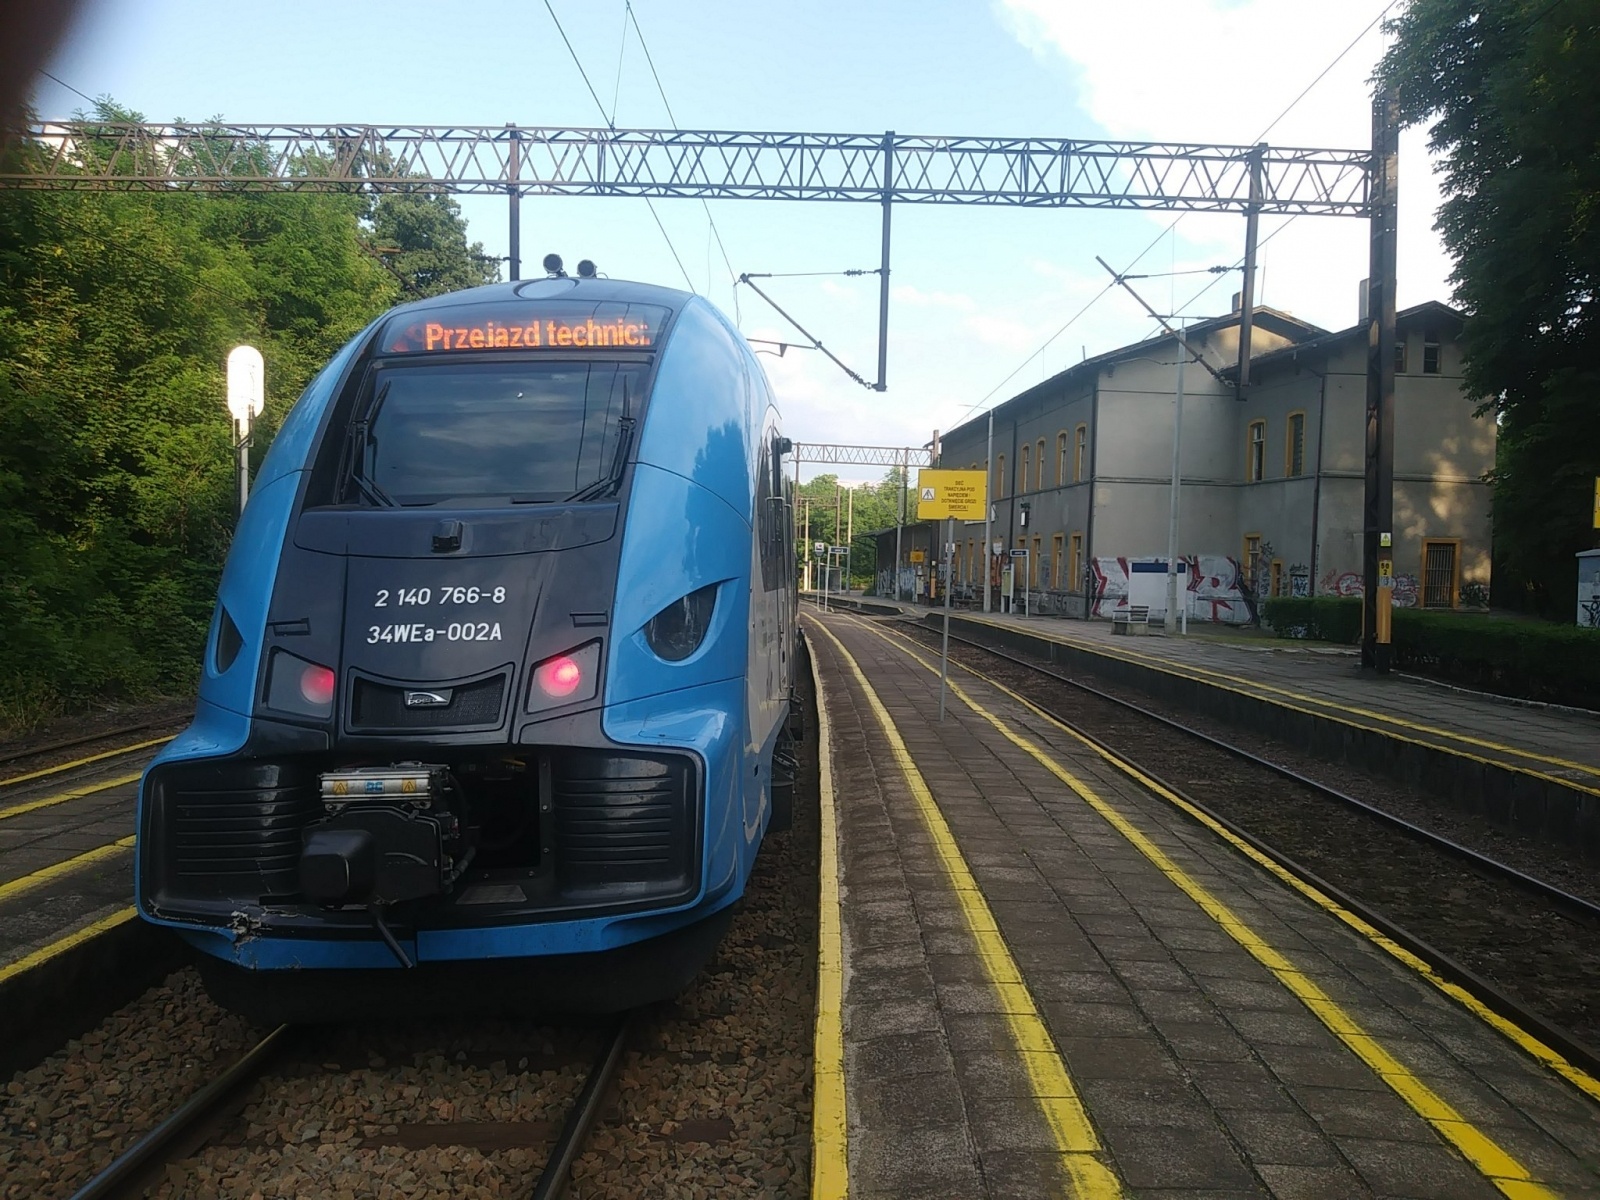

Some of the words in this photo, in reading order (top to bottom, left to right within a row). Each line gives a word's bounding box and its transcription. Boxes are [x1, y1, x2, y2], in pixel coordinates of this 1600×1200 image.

[426, 321, 540, 350] Przejazd
[547, 318, 650, 347] technic
[374, 589, 389, 607] 2
[398, 587, 431, 606] 140
[439, 586, 506, 604] 766-8
[366, 622, 502, 644] 34WEa-002A
